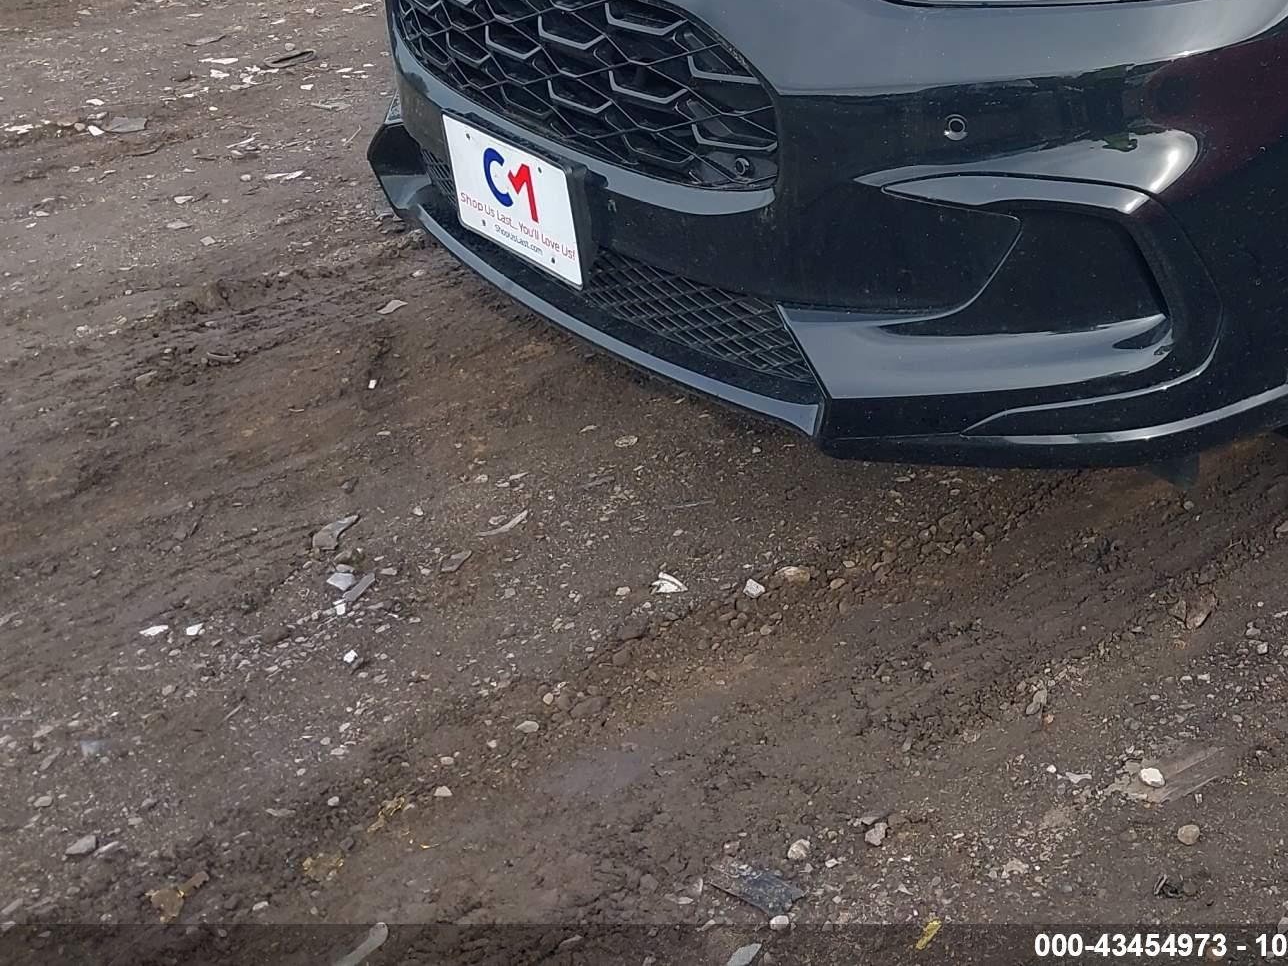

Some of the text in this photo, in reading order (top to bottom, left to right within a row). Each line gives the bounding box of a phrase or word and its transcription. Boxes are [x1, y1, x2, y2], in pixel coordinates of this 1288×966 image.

[460, 192, 484, 212] Shop
[484, 204, 496, 218] Us
[519, 221, 540, 241] You'll
[541, 233, 561, 252] Love
[561, 243, 576, 261] Us!
